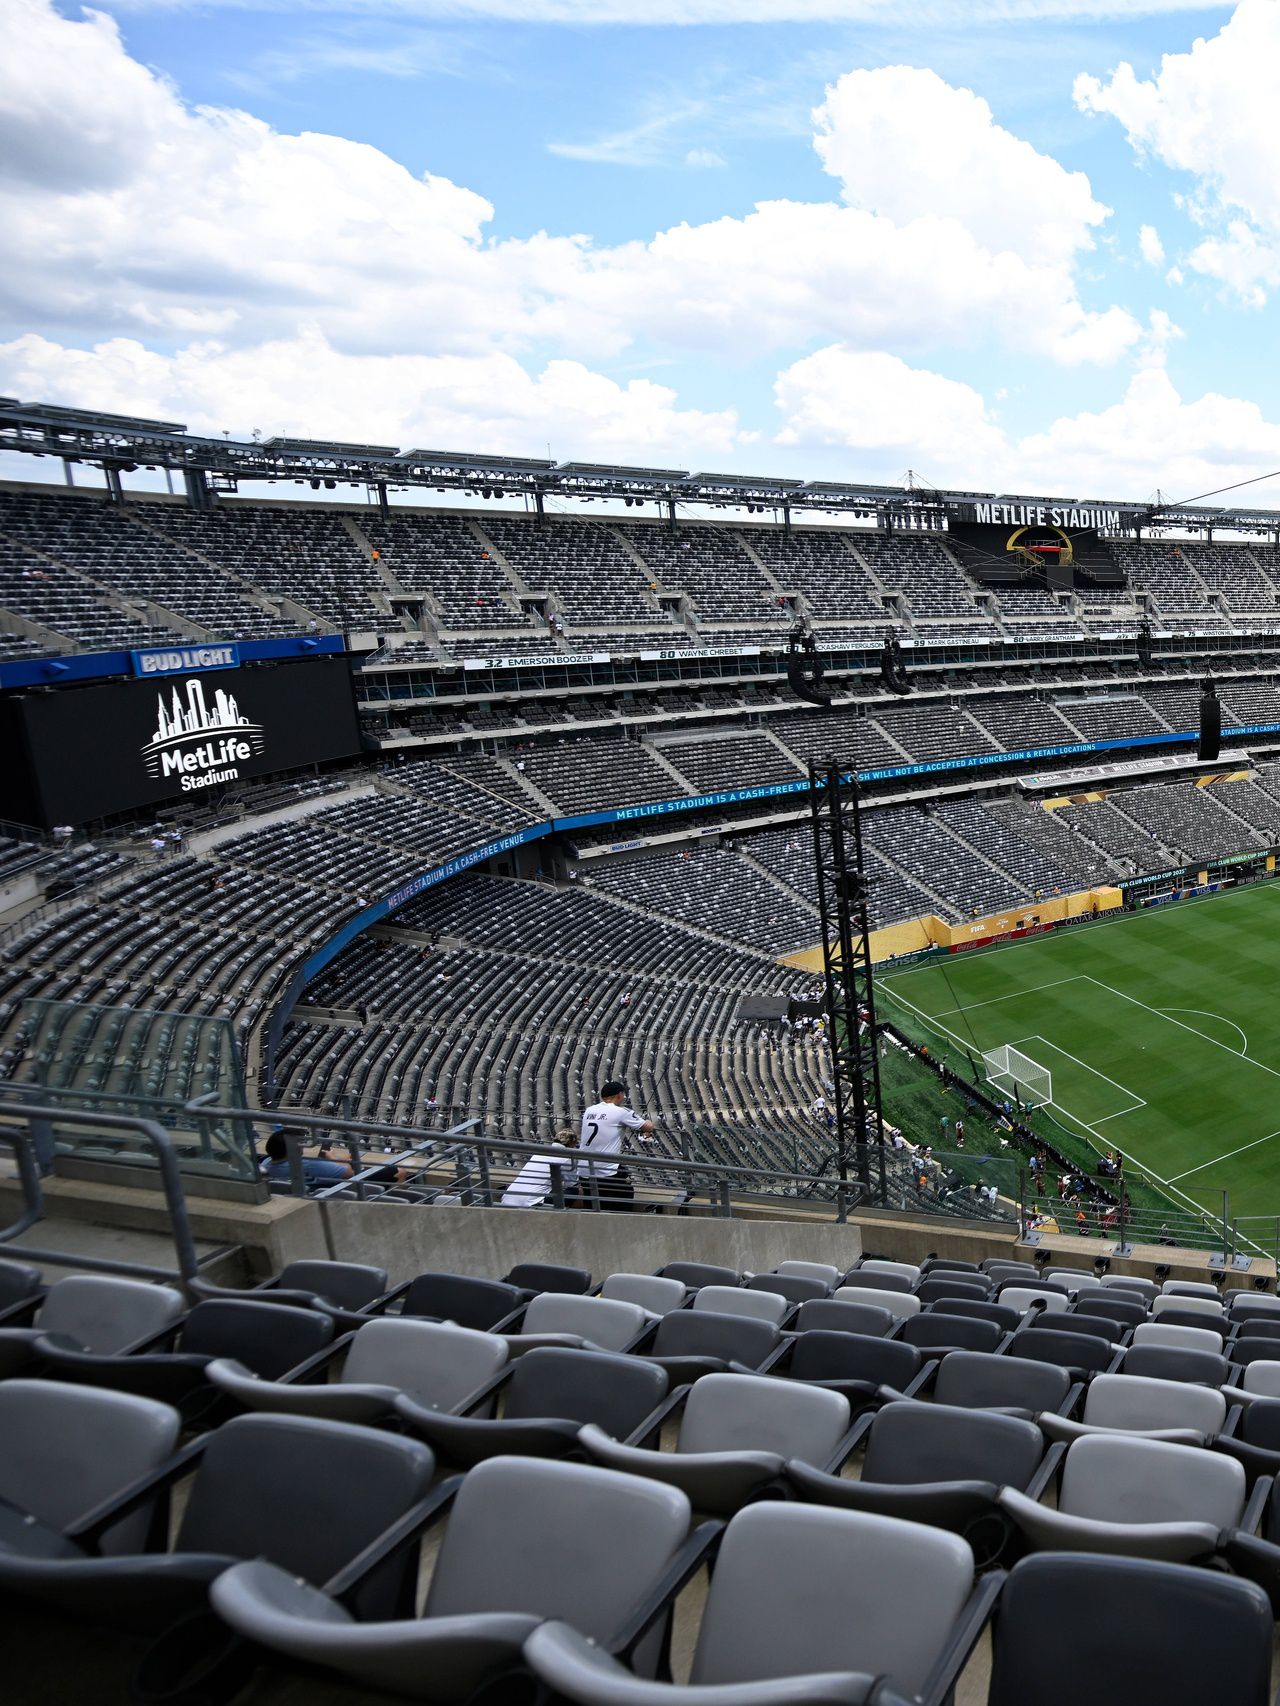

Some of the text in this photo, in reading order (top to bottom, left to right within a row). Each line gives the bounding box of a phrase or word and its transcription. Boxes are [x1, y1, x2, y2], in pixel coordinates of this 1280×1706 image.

[976, 503, 1120, 529] METLIFE STADIUM
[659, 648, 743, 660] 80 WAYNE CHREBET
[851, 641, 884, 650] FERGUSON
[140, 648, 234, 673] BUD LIGHT
[485, 655, 594, 668] 32 EMERSON BOOZER
[1221, 728, 1246, 736] STADIUM
[161, 738, 251, 777] MetLife
[873, 770, 893, 780] WILL
[895, 768, 911, 777] NOT
[913, 766, 924, 774] BE
[926, 760, 966, 772] ACCEPTED
[968, 757, 977, 766] AT
[979, 751, 1024, 765] CONCESSION
[1026, 751, 1032, 759] &
[1033, 747, 1058, 758] RETAIL
[1059, 743, 1096, 755] LOCATIONS
[181, 768, 238, 791] Stadium
[616, 805, 664, 820] METLIFE
[668, 797, 713, 811] STADIUM
[717, 794, 726, 803] IS
[730, 793, 737, 801] A
[739, 784, 794, 799] CASH-FREE
[625, 841, 642, 849] LIGHT
[1230, 855, 1248, 864] WORLD
[388, 834, 524, 909] METLIFE STADIUM IS A CASH-FREE VENUE
[1143, 875, 1162, 883] WORLD
[1157, 895, 1173, 904] VISA
[1065, 905, 1130, 926] QATAR AIRWAYS
[971, 924, 985, 933] FIFA
[586, 1123, 598, 1146] 7
